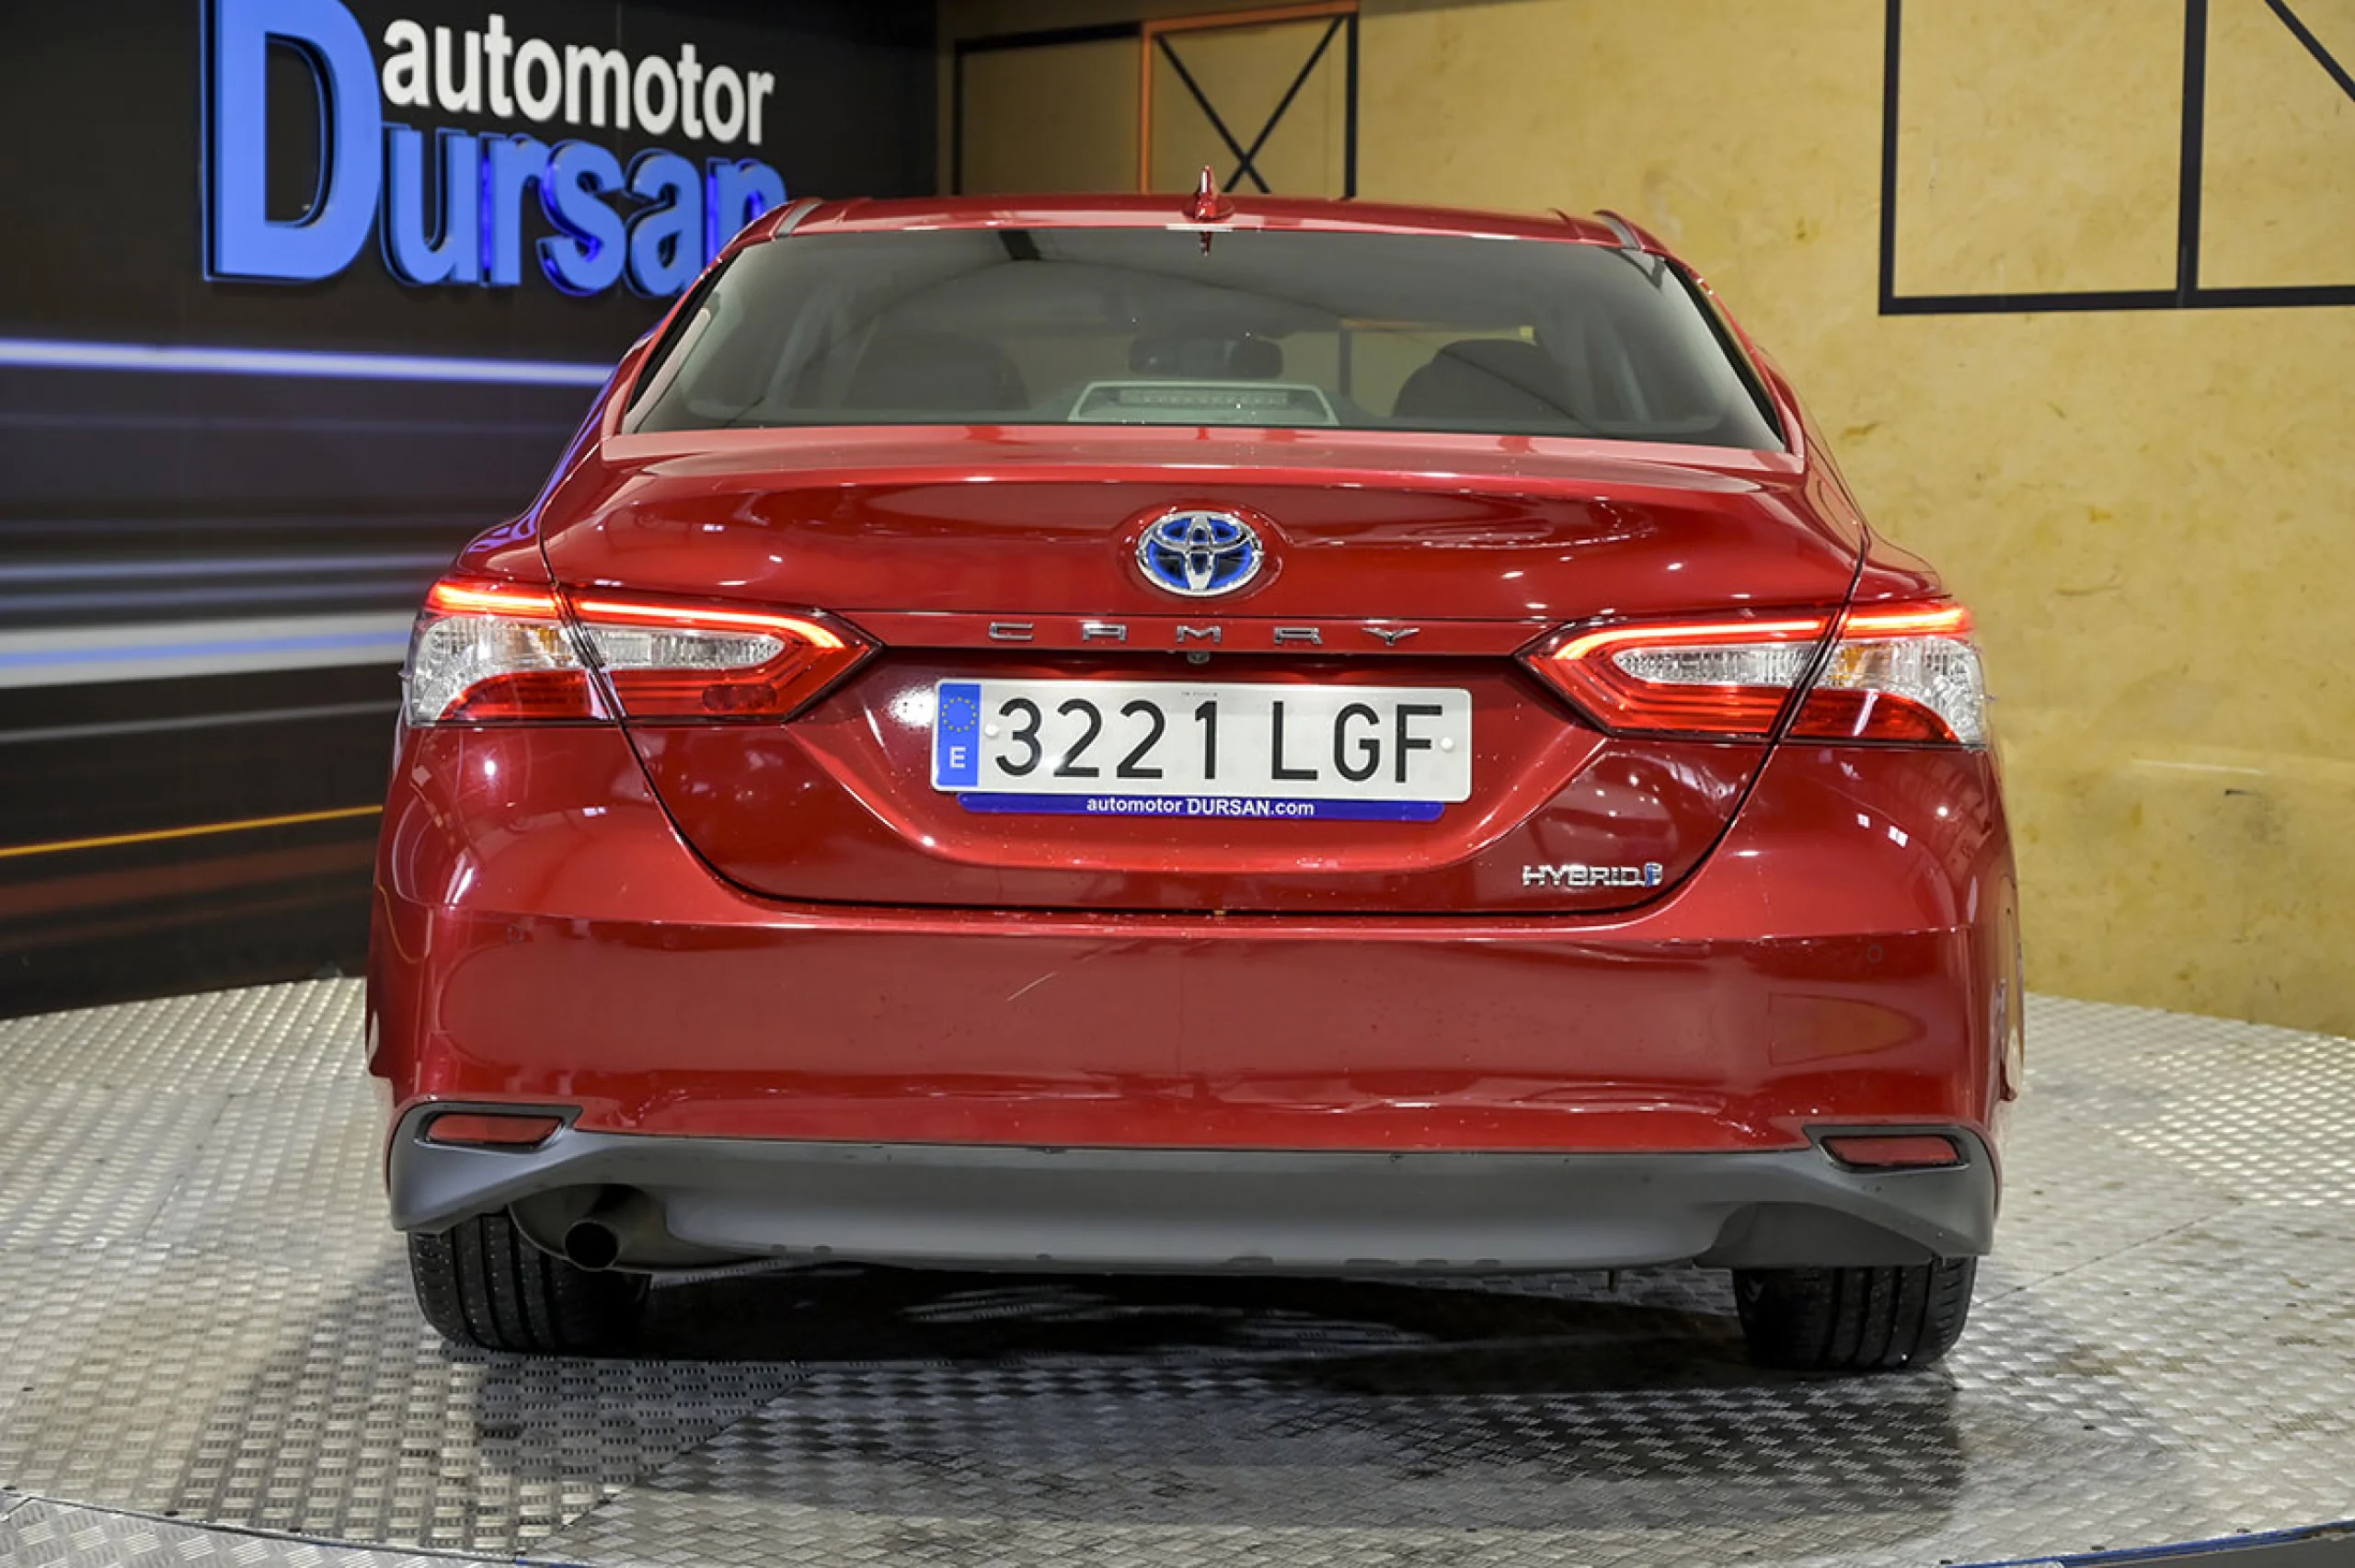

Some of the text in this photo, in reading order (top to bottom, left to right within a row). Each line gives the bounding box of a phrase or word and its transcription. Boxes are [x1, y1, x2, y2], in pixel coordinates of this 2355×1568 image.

[382, 14, 775, 144] automotor
[989, 622, 1419, 645] CAMRY
[995, 697, 1443, 784] 3221 LGF
[949, 746, 966, 769] E
[1086, 796, 1315, 817] automotor DURSAN.com
[1522, 864, 1645, 887] HYBRID
